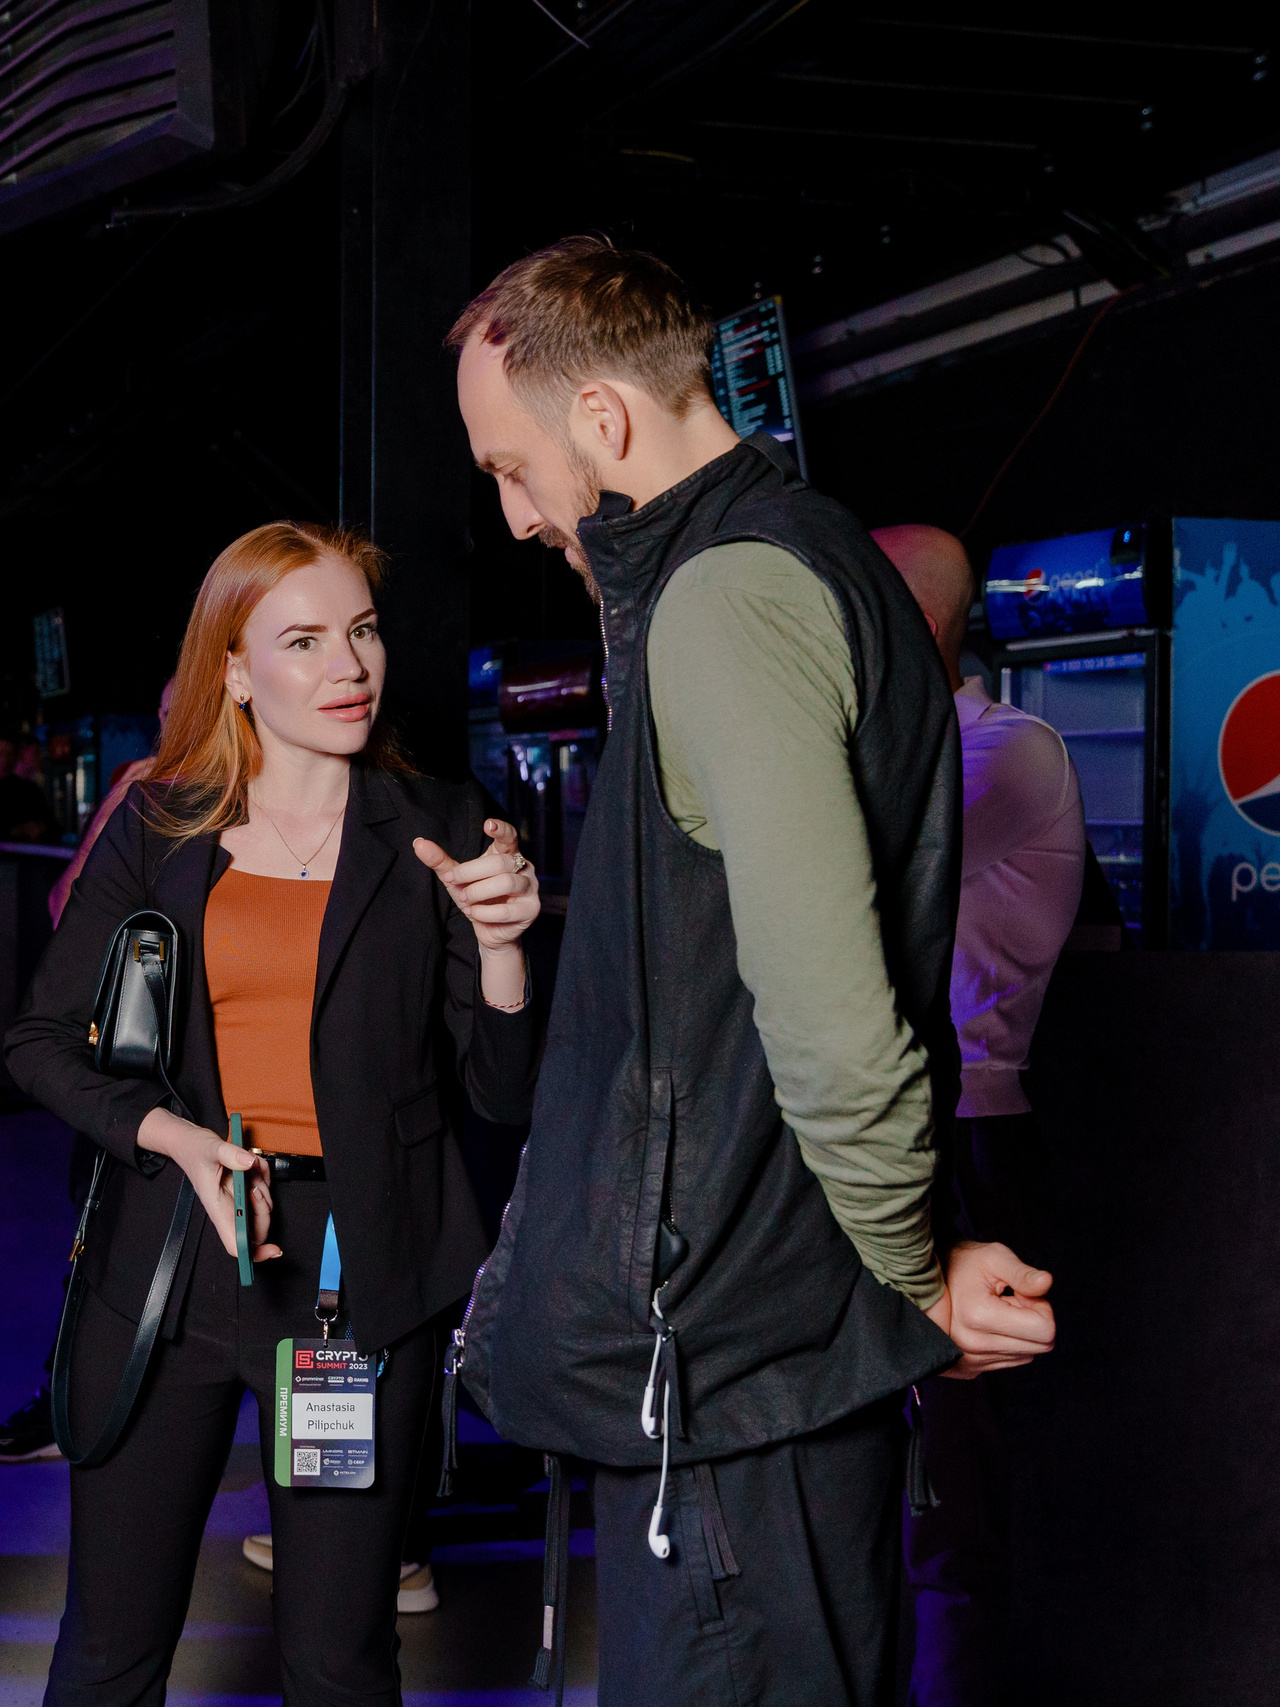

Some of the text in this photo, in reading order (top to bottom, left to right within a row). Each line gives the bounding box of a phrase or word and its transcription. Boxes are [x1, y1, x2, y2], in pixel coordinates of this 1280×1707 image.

[279, 1387, 288, 1437] ПРЕМИУМ
[306, 1402, 356, 1412] Anastasia
[307, 1420, 355, 1432] Pilipchuk
